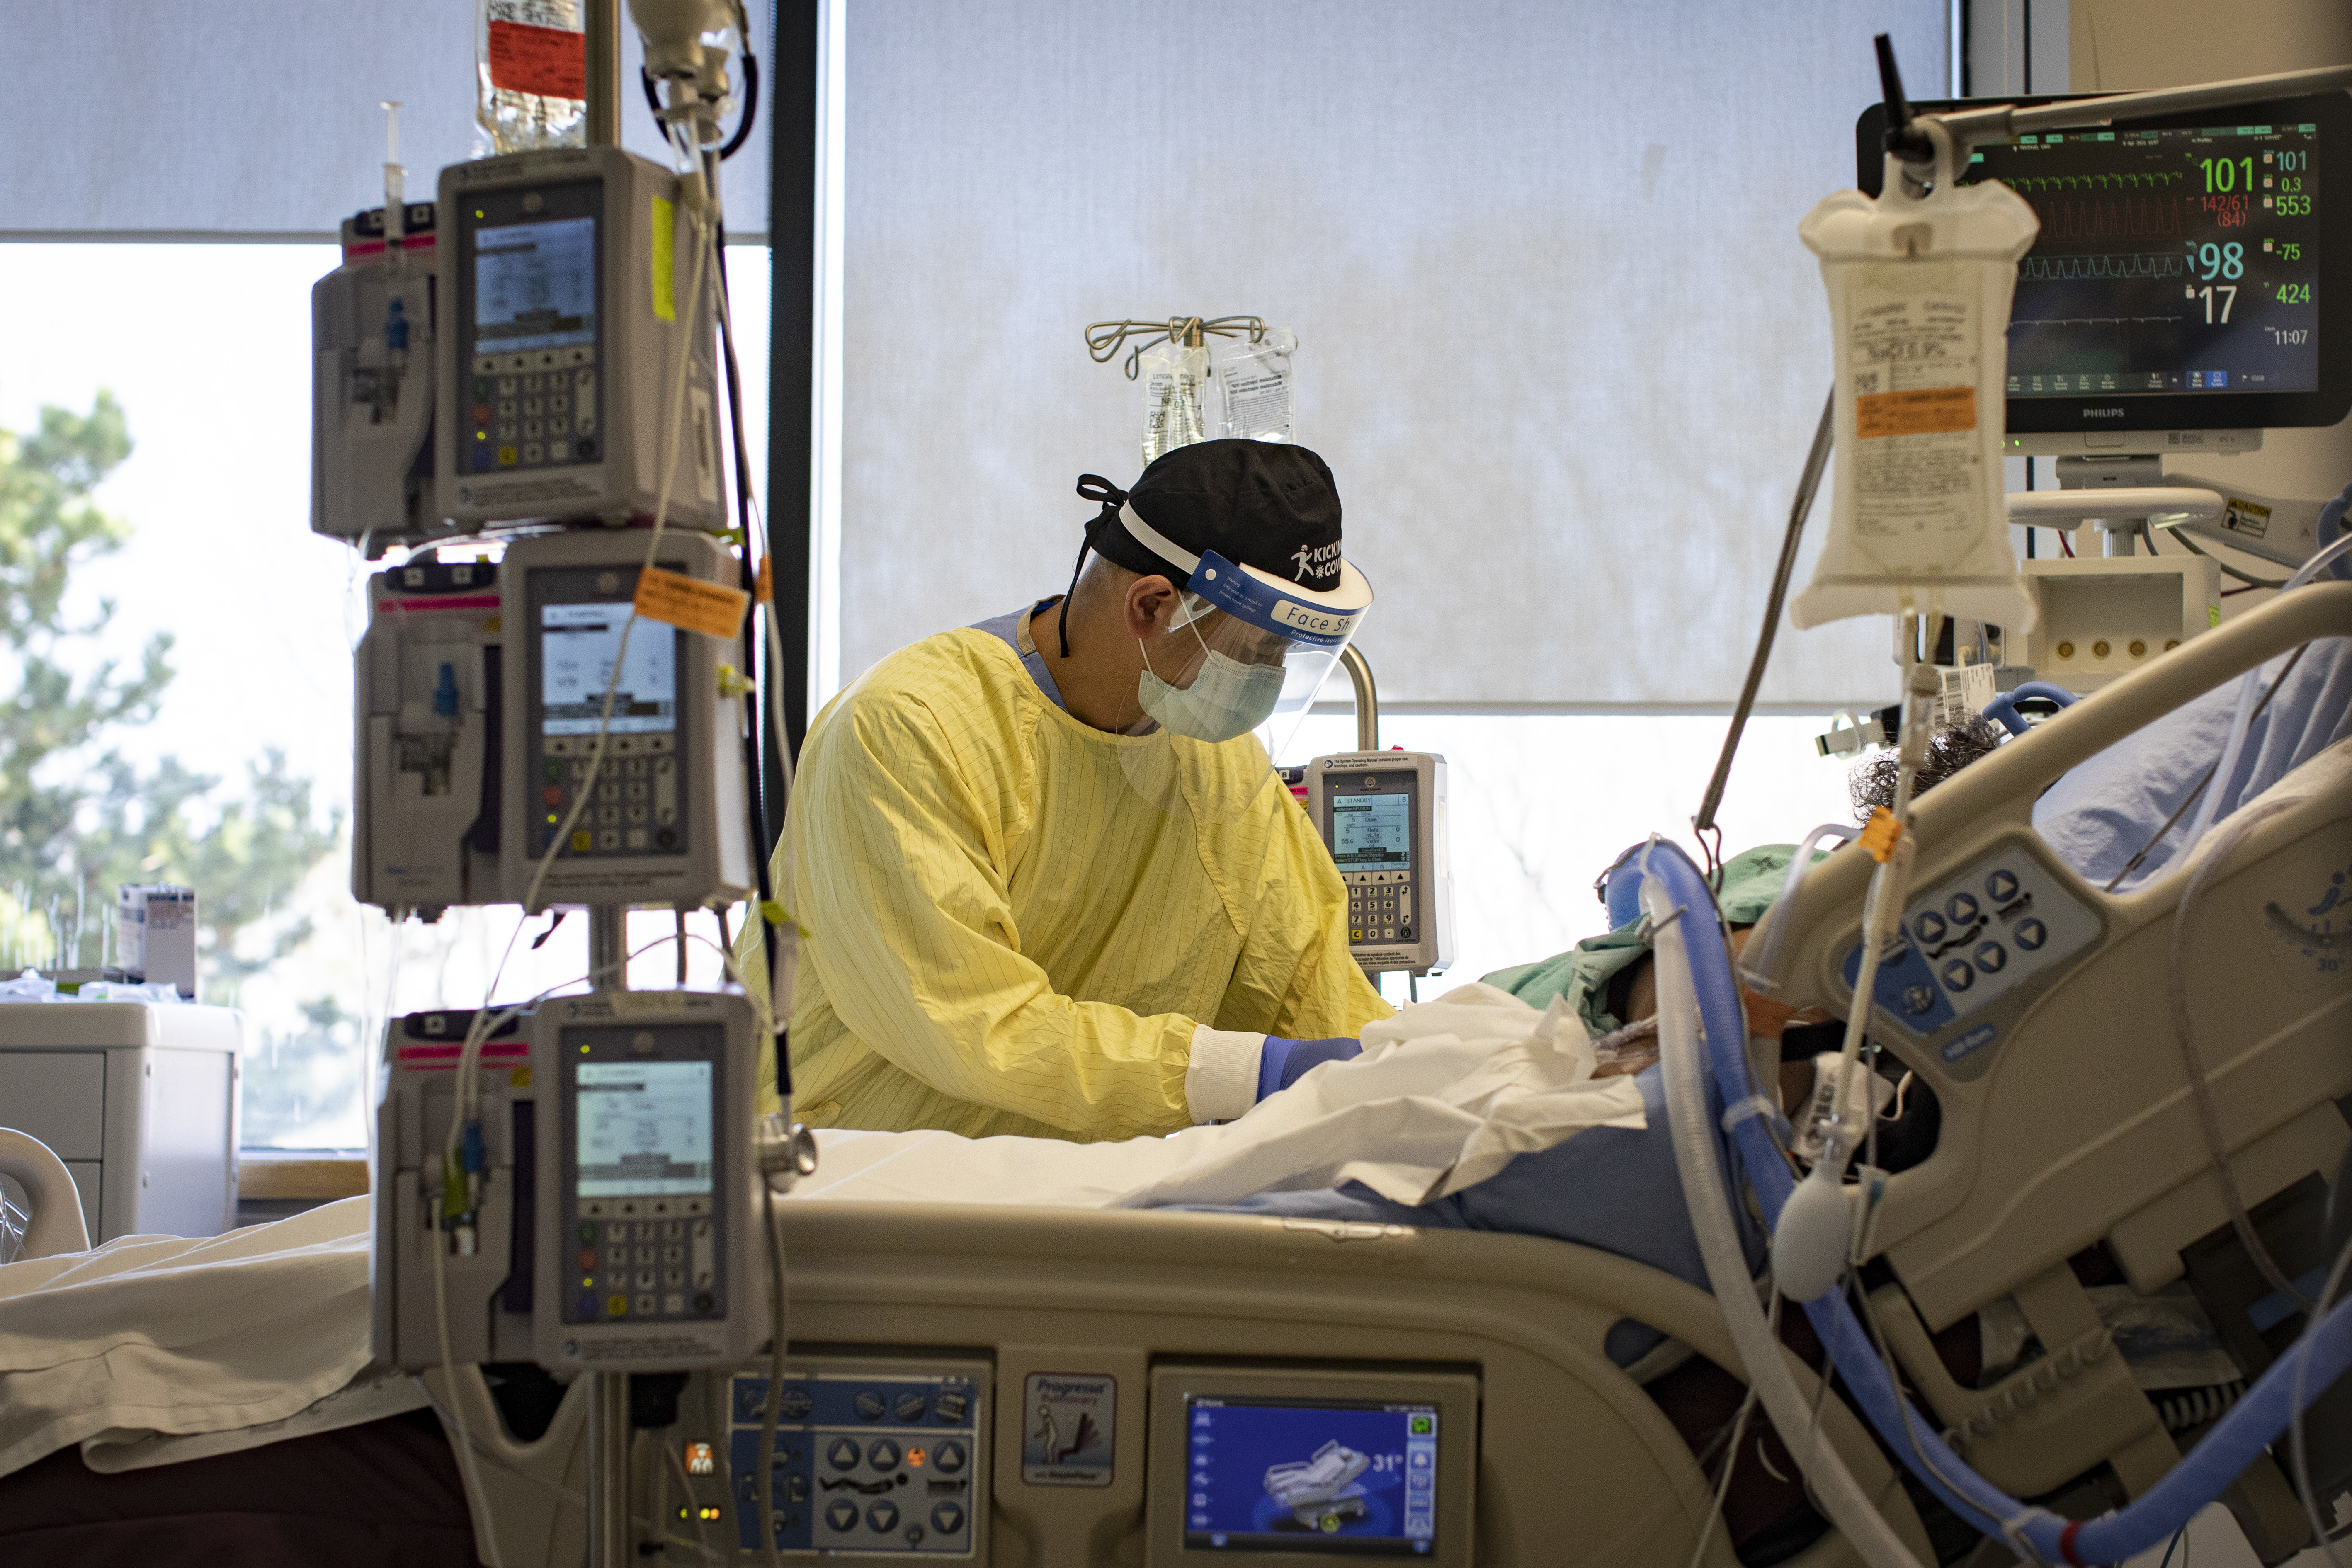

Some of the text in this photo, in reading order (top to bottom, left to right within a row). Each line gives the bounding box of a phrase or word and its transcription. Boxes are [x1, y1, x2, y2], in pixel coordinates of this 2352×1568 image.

[2276, 150, 2306, 172] 101
[2200, 156, 2252, 193] 101
[2282, 177, 2301, 192] 0.3
[2201, 194, 2248, 211] 142/61
[2276, 195, 2311, 216] 553
[2218, 211, 2245, 227] (84)
[2199, 242, 2243, 281] 98
[2276, 243, 2300, 260] -75
[2276, 283, 2310, 304] 424
[2199, 286, 2237, 324] 17
[2275, 330, 2308, 345] 11:07
[2083, 408, 2124, 418] PHILIPS
[1227, 576, 1240, 587] Warning
[1219, 590, 1256, 612] prevent liquid spillage
[1286, 607, 1329, 630] Face
[1291, 629, 1324, 643] Protective
[1373, 1453, 1403, 1473] 31°
